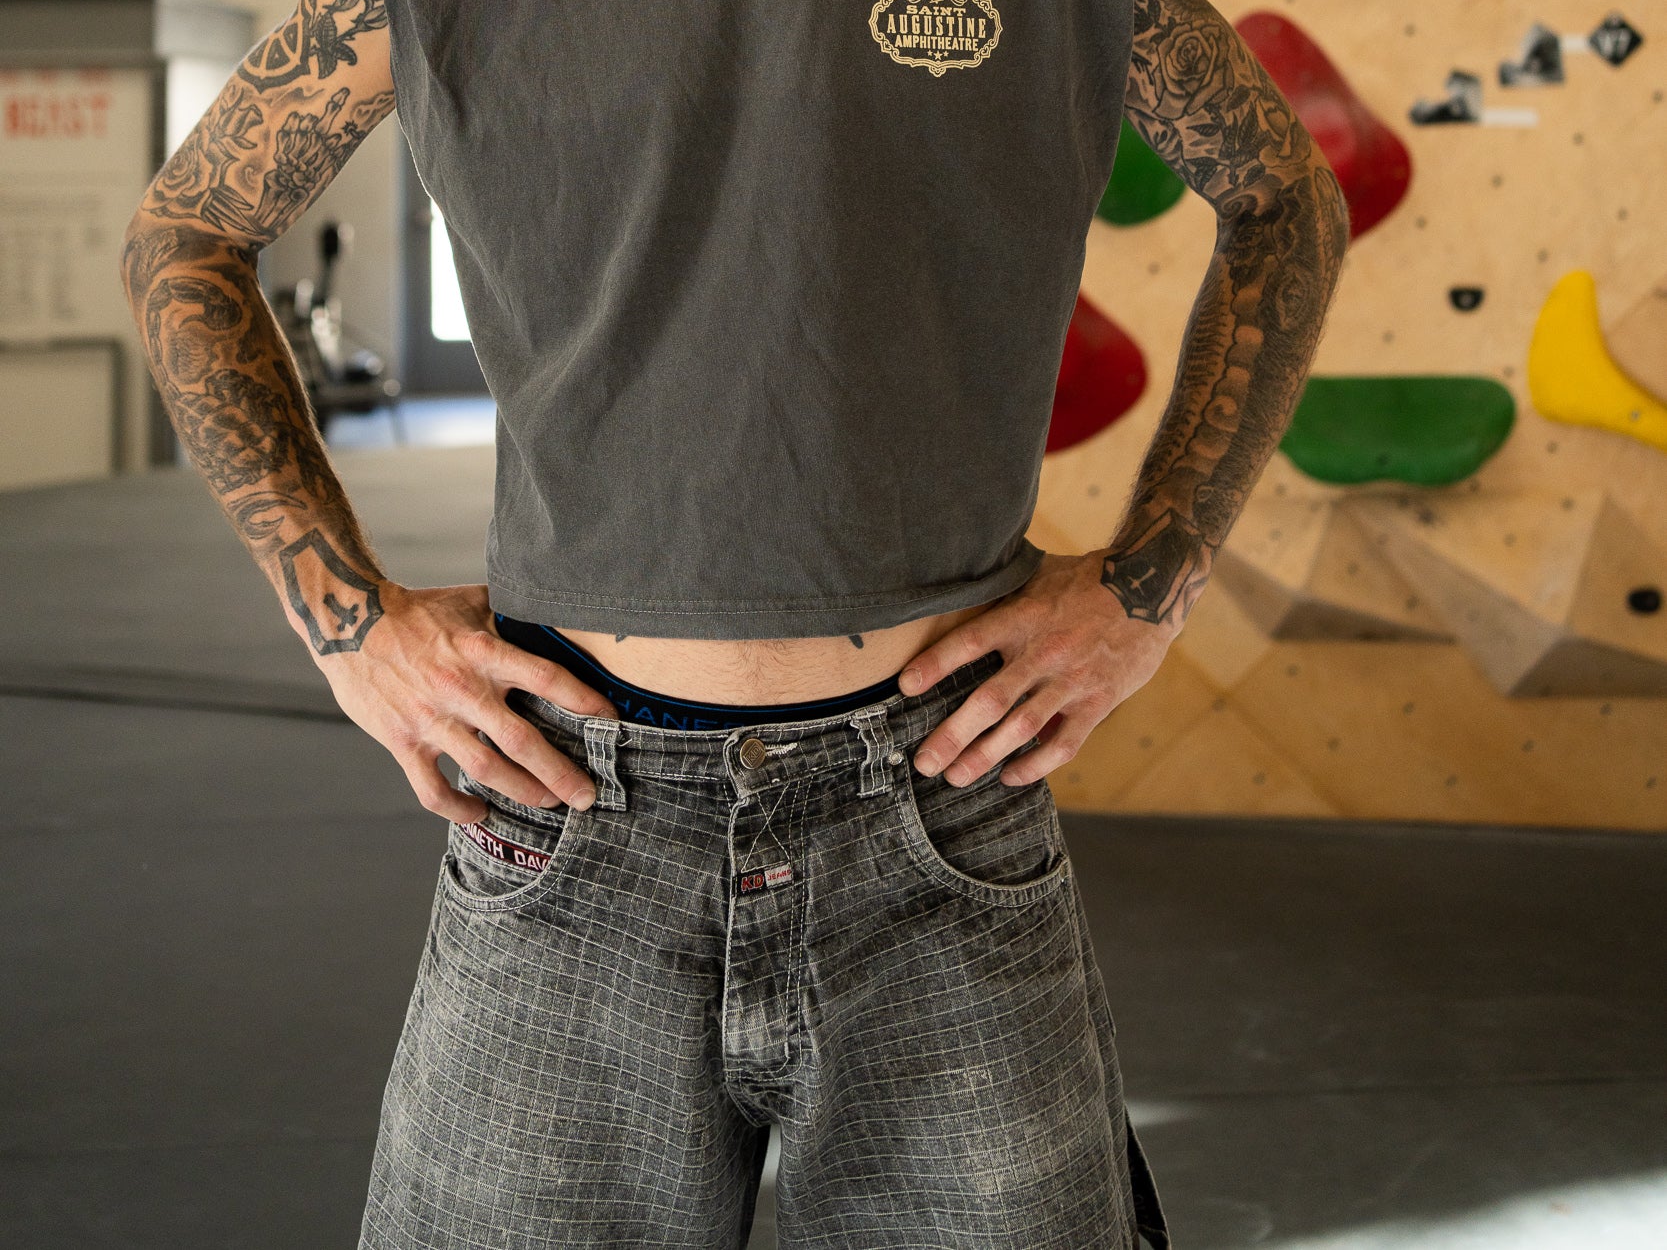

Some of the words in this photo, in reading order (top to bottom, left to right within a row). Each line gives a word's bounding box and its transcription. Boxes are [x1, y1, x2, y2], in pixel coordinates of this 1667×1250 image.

[906, 4, 967, 17] SAINT
[886, 13, 987, 39] AUGUSTINE
[894, 34, 980, 52] AMPHITHEATRE
[461, 823, 504, 859] ENNETH
[513, 849, 551, 871] DAV
[741, 873, 764, 892] KD
